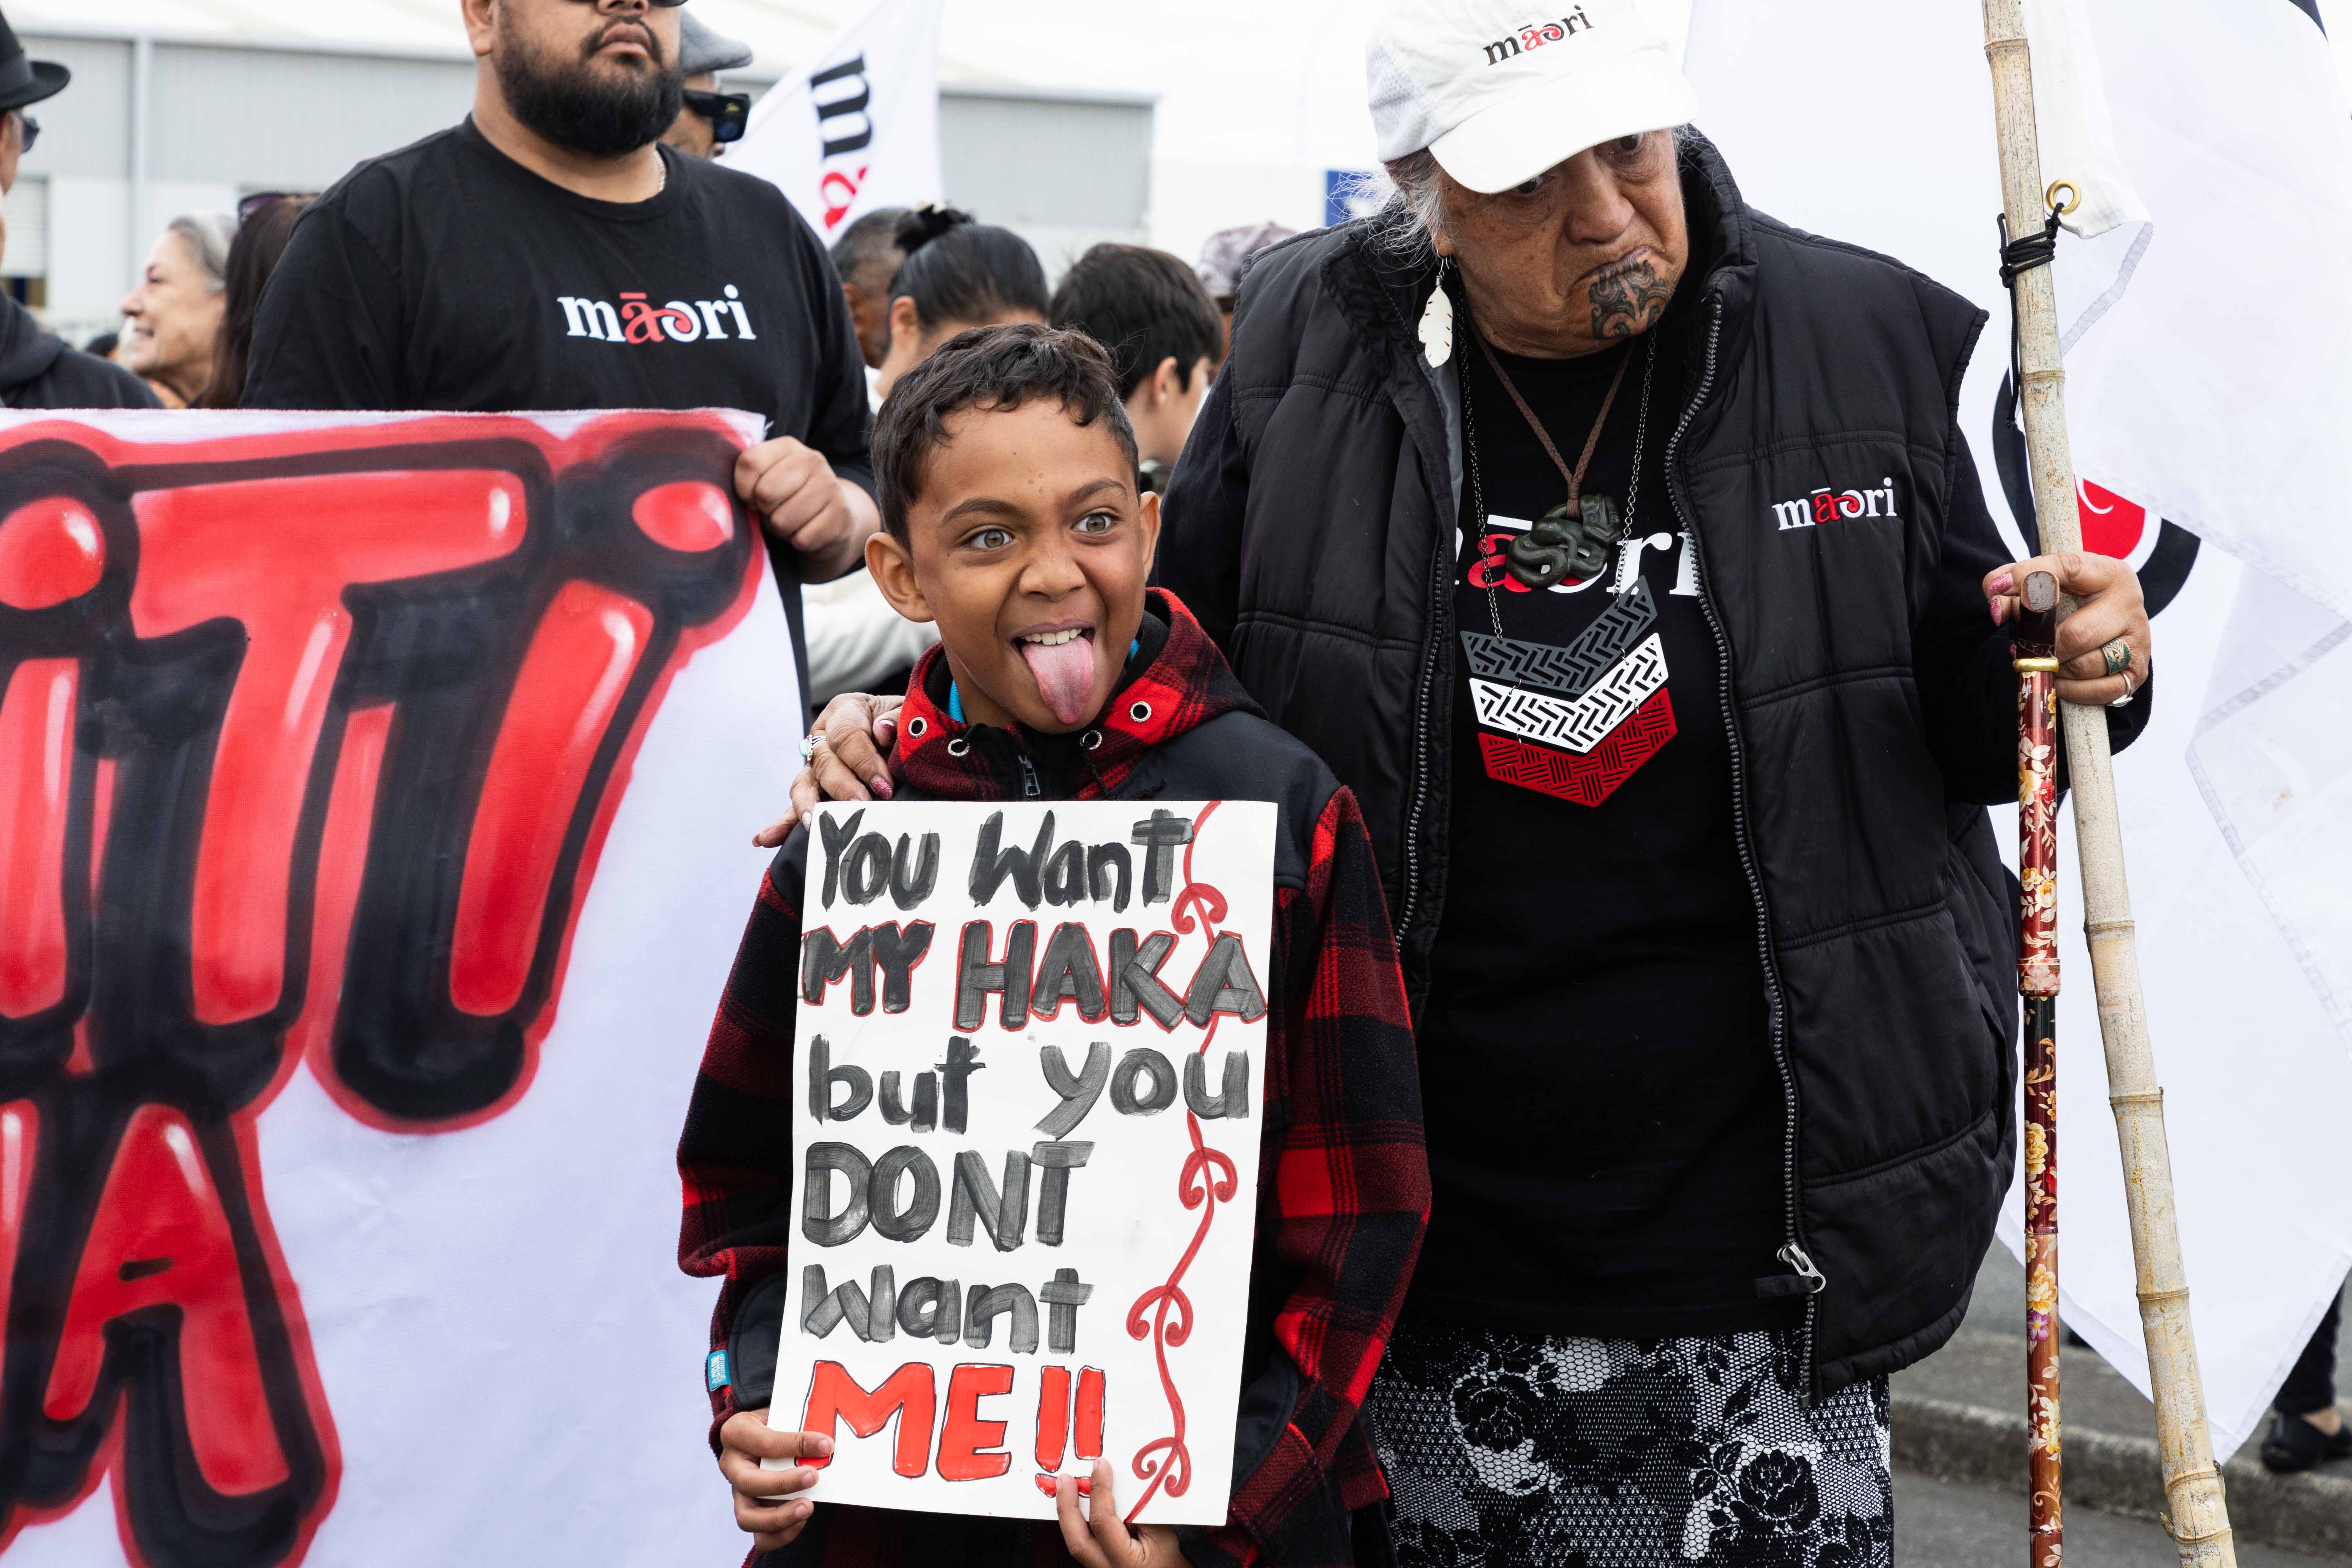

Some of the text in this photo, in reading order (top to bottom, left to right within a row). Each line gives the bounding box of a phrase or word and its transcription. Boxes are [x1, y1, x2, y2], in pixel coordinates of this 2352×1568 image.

[1483, 5, 1595, 65] māori
[557, 284, 757, 344] māori
[1772, 477, 1897, 530] māori
[968, 808, 1194, 913] Want
[801, 919, 1268, 1033] MY HAKA
[809, 1033, 1249, 1140] but you
[802, 1141, 1095, 1252] DONT
[800, 1263, 1094, 1355] Want
